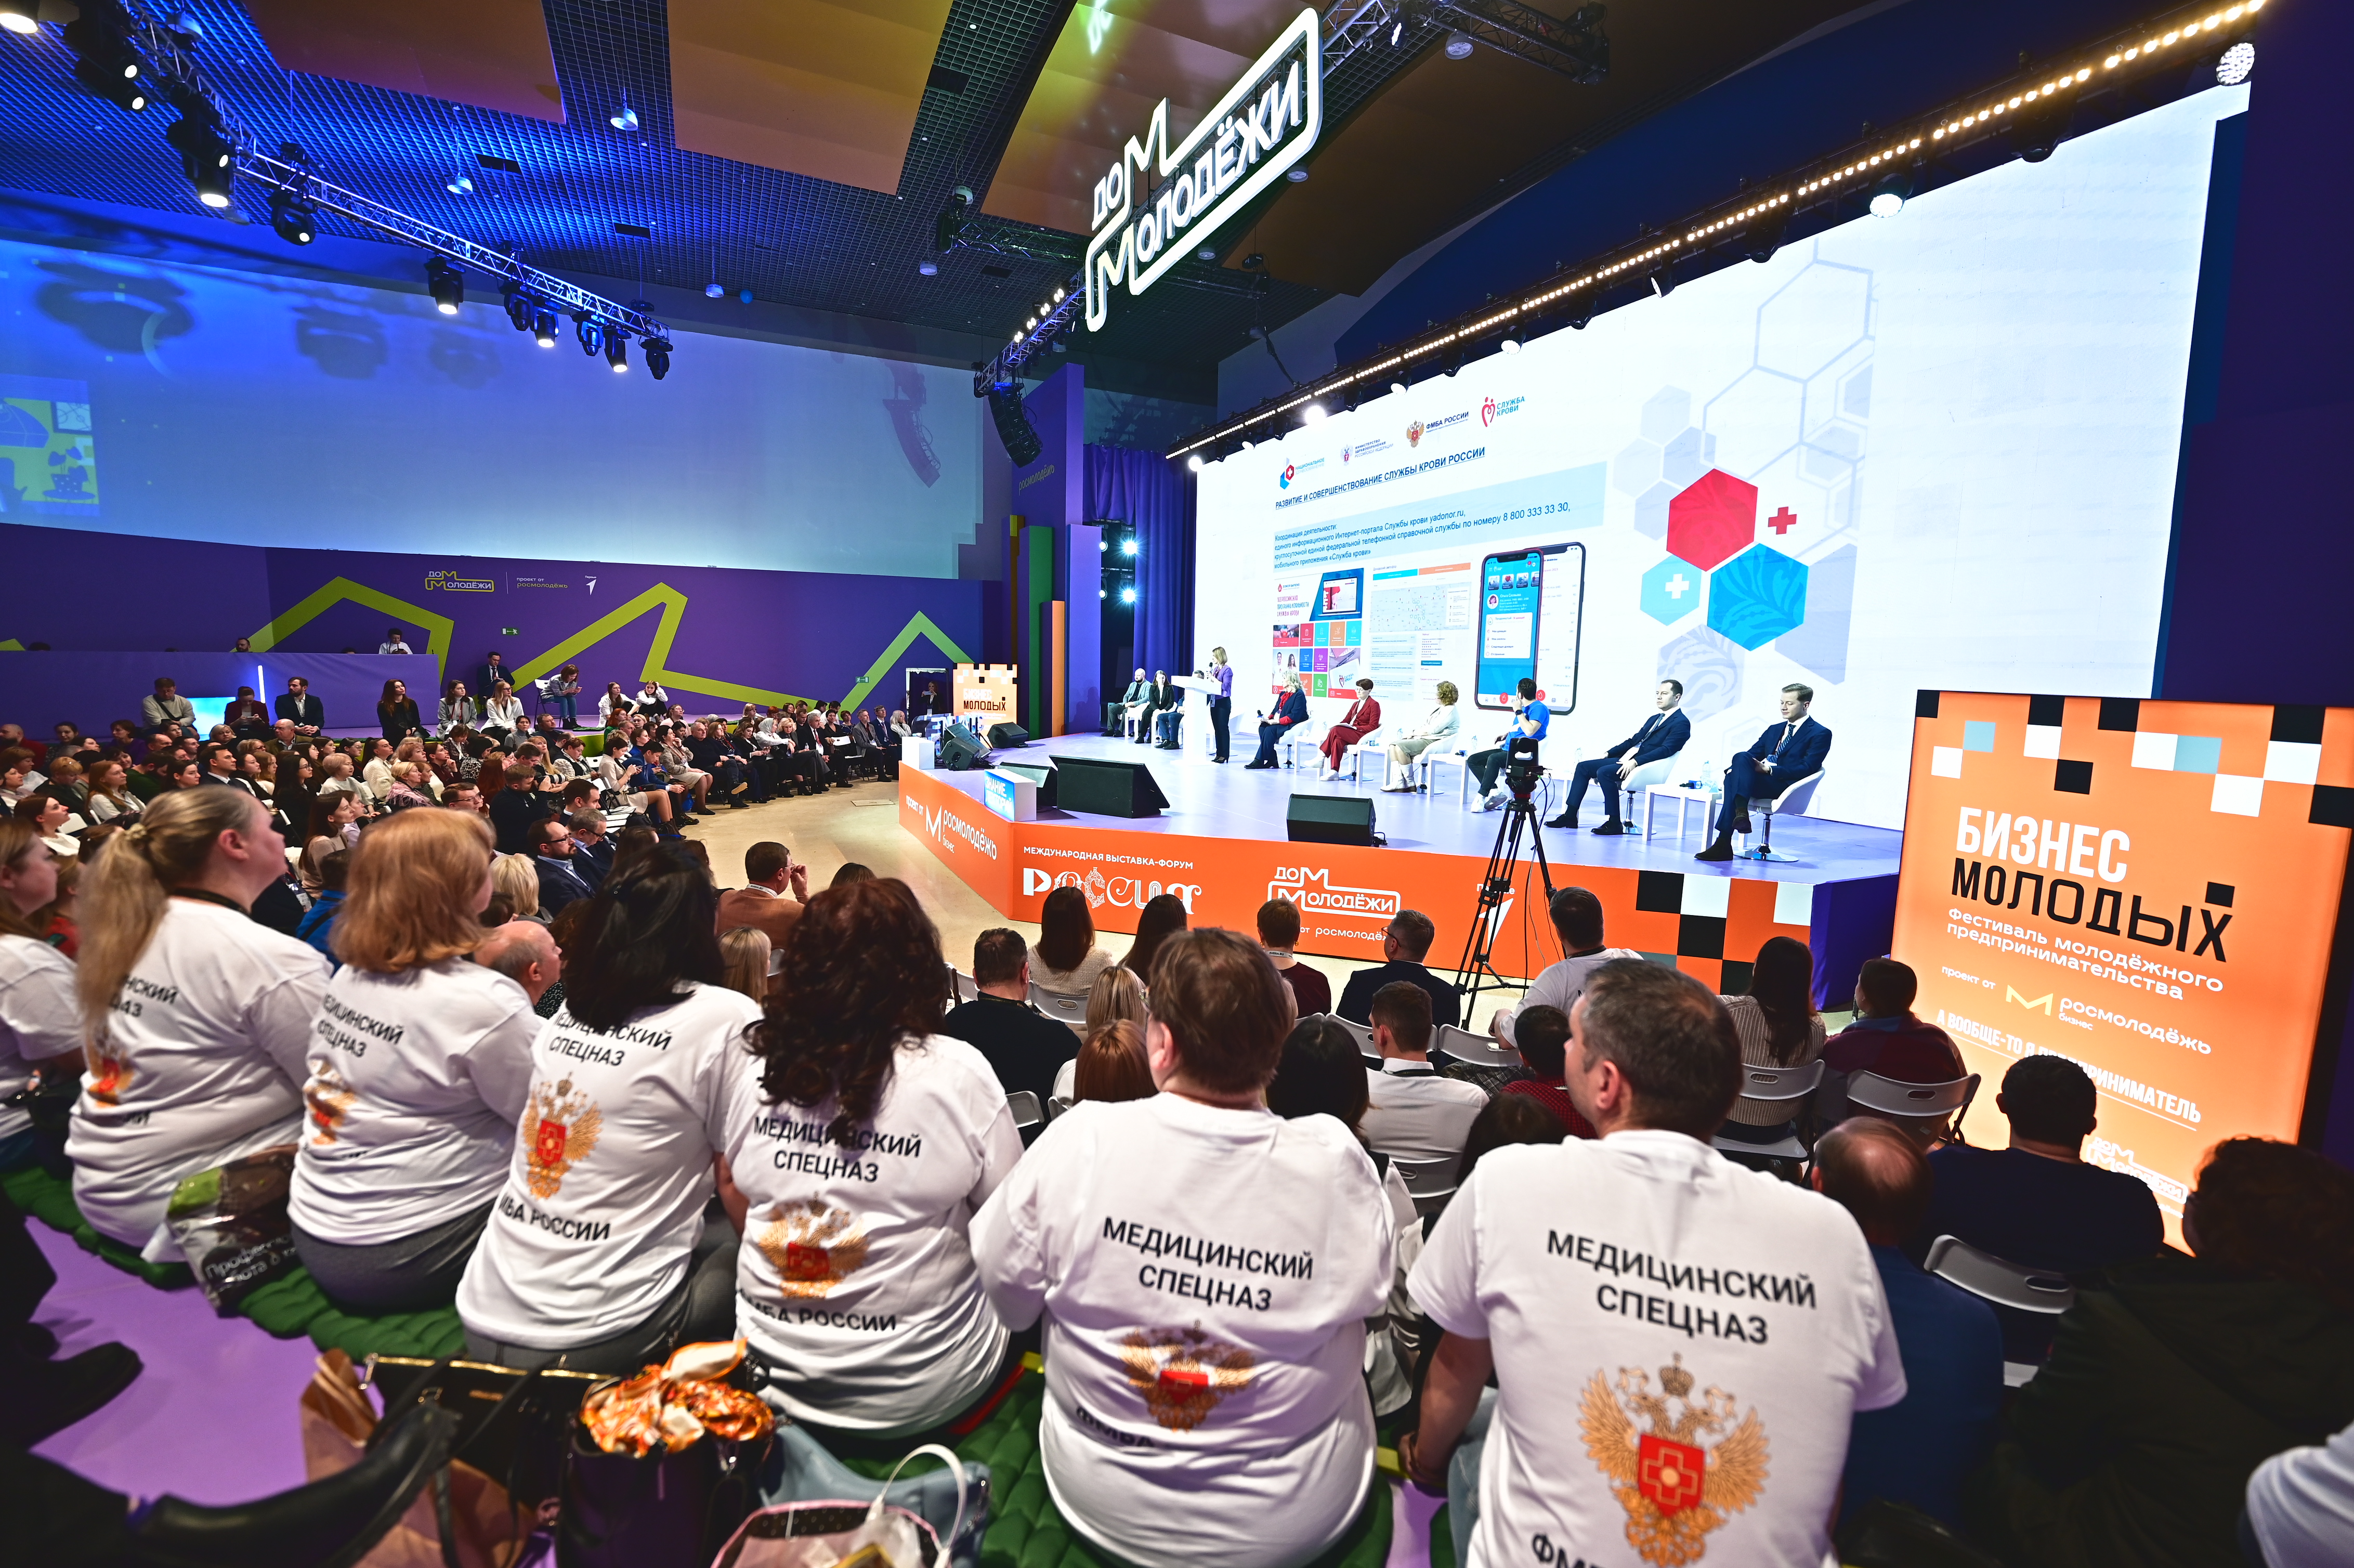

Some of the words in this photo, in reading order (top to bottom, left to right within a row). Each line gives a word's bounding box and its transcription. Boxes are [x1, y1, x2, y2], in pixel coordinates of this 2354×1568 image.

[1092, 97, 1171, 231] ДОМ
[1096, 60, 1303, 322] МОЛОДЁЖИ
[1497, 396, 1525, 409] СЛУЖБА
[1497, 405, 1519, 416] КРОВИ
[1426, 420, 1443, 429] ФМБА
[1444, 411, 1469, 424] РОССИИ
[1355, 439, 1380, 450] МИНИСТЕРСТВО
[1276, 495, 1303, 508] РАЗВИТИЕ
[1309, 474, 1382, 500] СОВЕРШЕНСТВОВАНИЕ
[1384, 464, 1417, 481] СЛУЖБЫ
[1419, 456, 1446, 472] КРОВИ
[1448, 447, 1485, 464] РОССИИ
[1295, 458, 1325, 471] НАЦИОНАЛЬНОЕ
[1274, 548, 1307, 560] круглосуточной
[1308, 544, 1325, 554] единой
[1326, 539, 1361, 552] федеральной
[1362, 532, 1396, 545] телефонной
[1397, 526, 1433, 539] справочной
[1435, 522, 1461, 534] службы
[1473, 515, 1501, 527] номеру
[1503, 513, 1508, 521] 8
[1510, 510, 1525, 520] 800
[1527, 507, 1542, 517] 333
[1545, 504, 1555, 515] 33
[1558, 502, 1570, 513] 30,
[1275, 531, 1303, 542] Координация
[1304, 524, 1337, 536] деятельности:
[1292, 534, 1334, 547] информационного
[1335, 525, 1383, 539] Интернет-портала
[1384, 519, 1408, 531] Службы
[1410, 517, 1428, 526] крови
[1429, 509, 1466, 524] yadonor.ru,
[1274, 560, 1299, 569] мобильного
[1300, 556, 1328, 567] приложения
[1329, 551, 1352, 561] «Служба
[1353, 550, 1371, 558] крови»
[431, 581, 491, 590] МОЛОДЁЖИ
[963, 688, 992, 700] БИЗНЕС
[963, 700, 1006, 711] МОЛОДЫХ
[906, 795, 919, 812] проект
[919, 804, 924, 816] от
[943, 809, 997, 860] росмолодёжь
[943, 834, 954, 854] бизнес
[1955, 806, 2131, 883] БИЗНЕС
[1024, 846, 1104, 862] МЕЖДУНАРОДНАЯ
[1105, 854, 1193, 870] ВЫСТАВКА-ФОРУМ
[1274, 867, 1329, 886] ДОМ
[1277, 887, 1393, 913] МОЛОДЁЖИ
[1952, 858, 2234, 963] МОЛОДЫХ
[1315, 927, 1387, 942] росмолодё
[1947, 922, 2184, 1001] предпринимательства
[1948, 908, 2048, 945] Фестиваль
[2055, 938, 2224, 992] молодёжного
[1942, 965, 1979, 984] проект
[1981, 979, 1996, 990] от
[1936, 1009, 1945, 1025] А
[1947, 1012, 2023, 1054] ВООБЩЕ-ТО
[2025, 1042, 2035, 1057] Я
[2058, 1012, 2093, 1030] бизнес
[2059, 997, 2212, 1055] росмолодёжь
[549, 1036, 625, 1066] СПЕЦНАЗ
[774, 1150, 879, 1183] СПЕЦНАЗ
[530, 1208, 611, 1242] РОССИИ
[1103, 1216, 1314, 1280] МЕДИЦИНСКИЙ
[1547, 1230, 1817, 1310] МЕДИЦИНСКИЙ
[1139, 1265, 1273, 1312] СПЕЦНАЗ
[799, 1308, 897, 1332] РОССИИ
[1597, 1284, 1769, 1345] СПЕЦНАЗ
